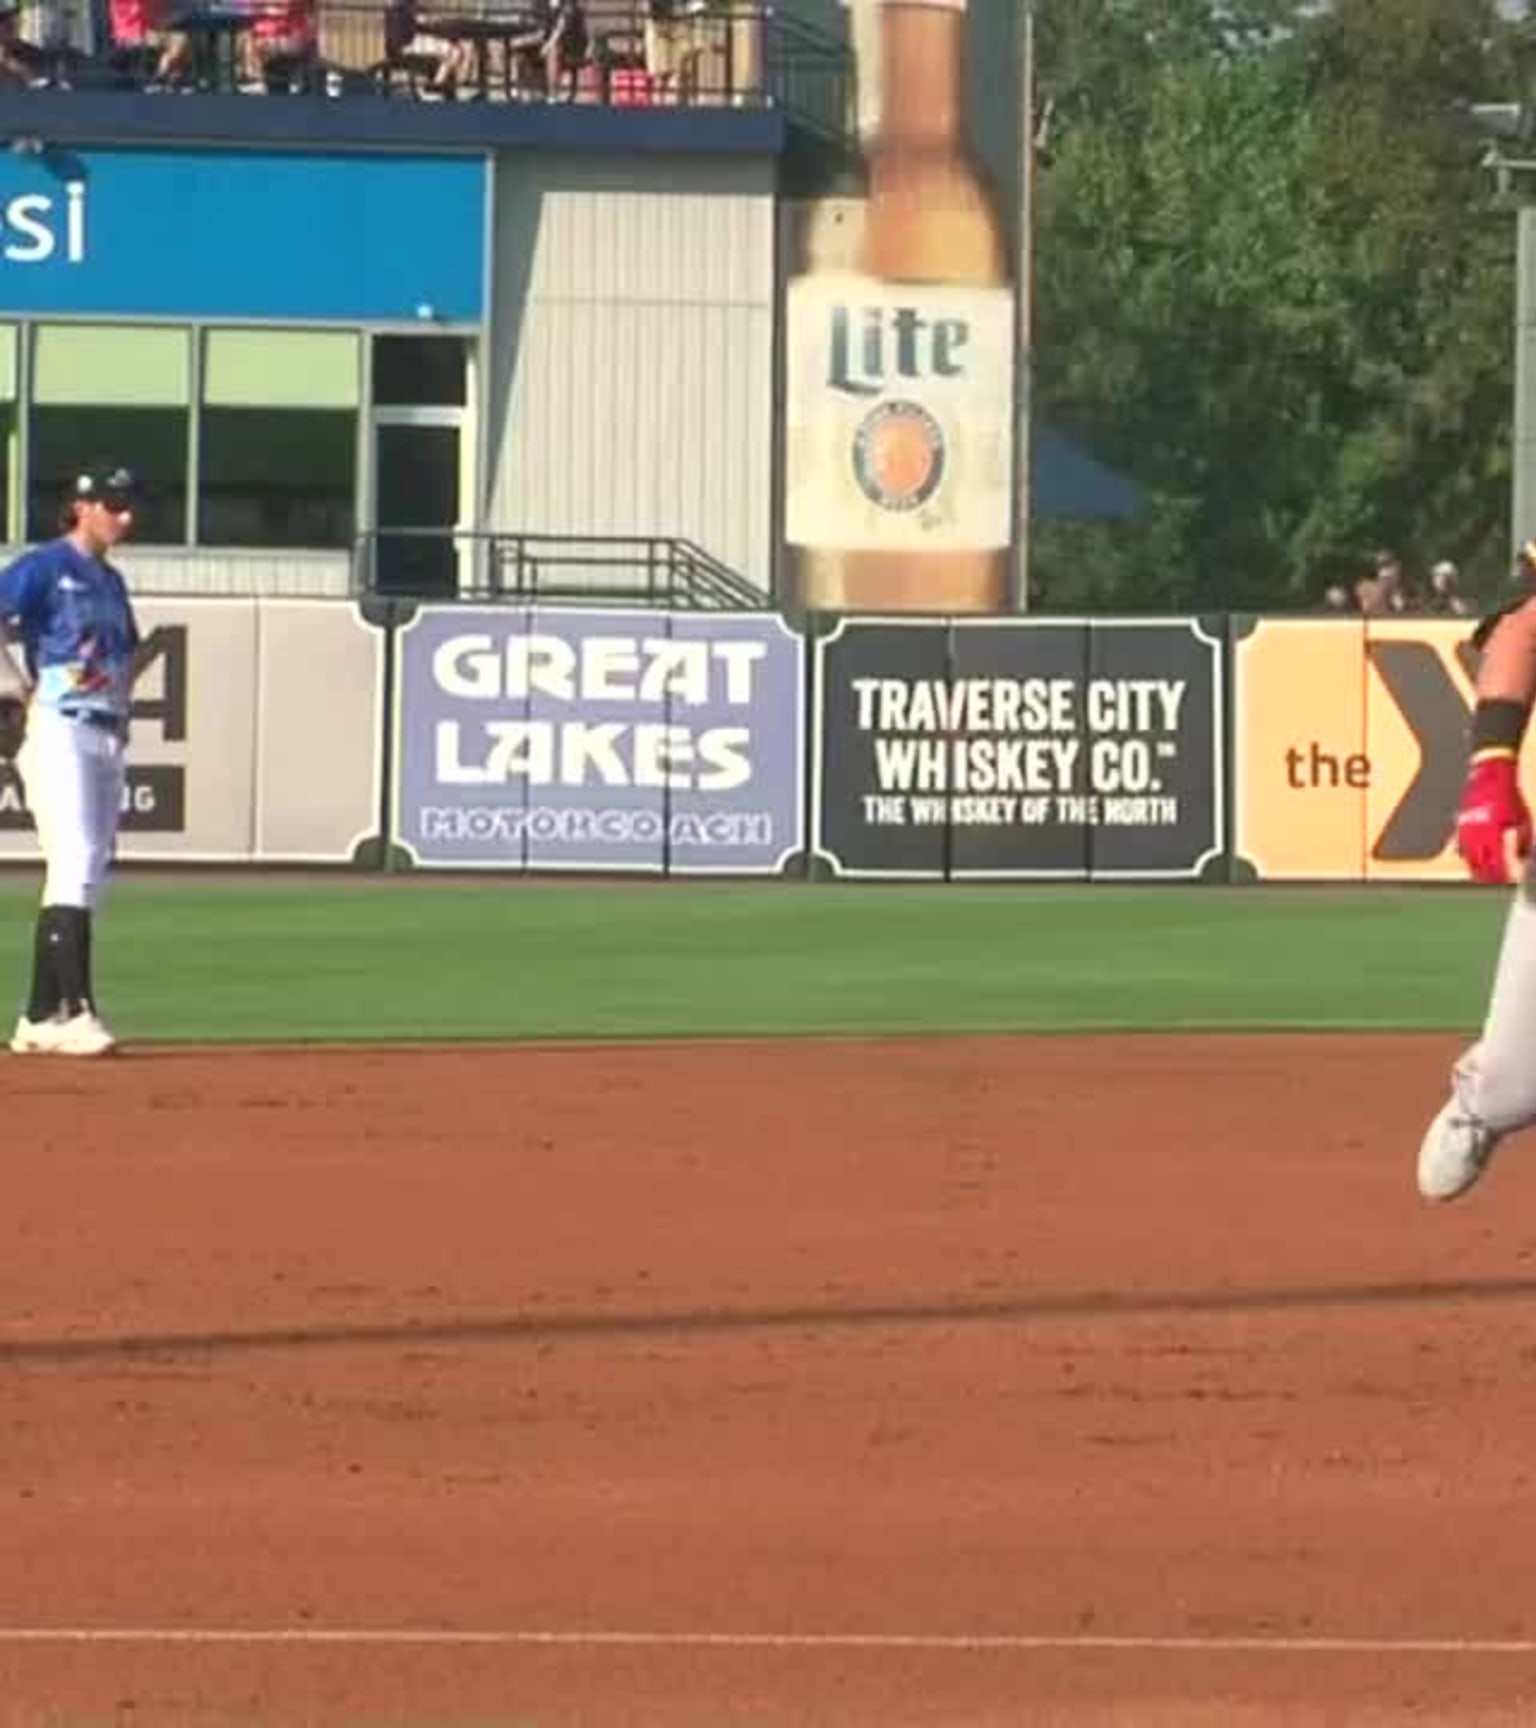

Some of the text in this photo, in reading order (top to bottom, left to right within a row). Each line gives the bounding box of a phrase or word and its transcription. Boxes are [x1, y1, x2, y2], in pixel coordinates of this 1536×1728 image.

[826, 307, 968, 395] Lite
[433, 634, 768, 704] GREAT
[851, 678, 1185, 731] TRAVERSE CITY
[435, 720, 752, 790] LAKES
[874, 739, 1079, 791] WHISKEY
[1285, 742, 1372, 788] the
[420, 806, 774, 846] MOTORCOACH
[864, 796, 1177, 825] THE WHISKEY OF THE NORTH
